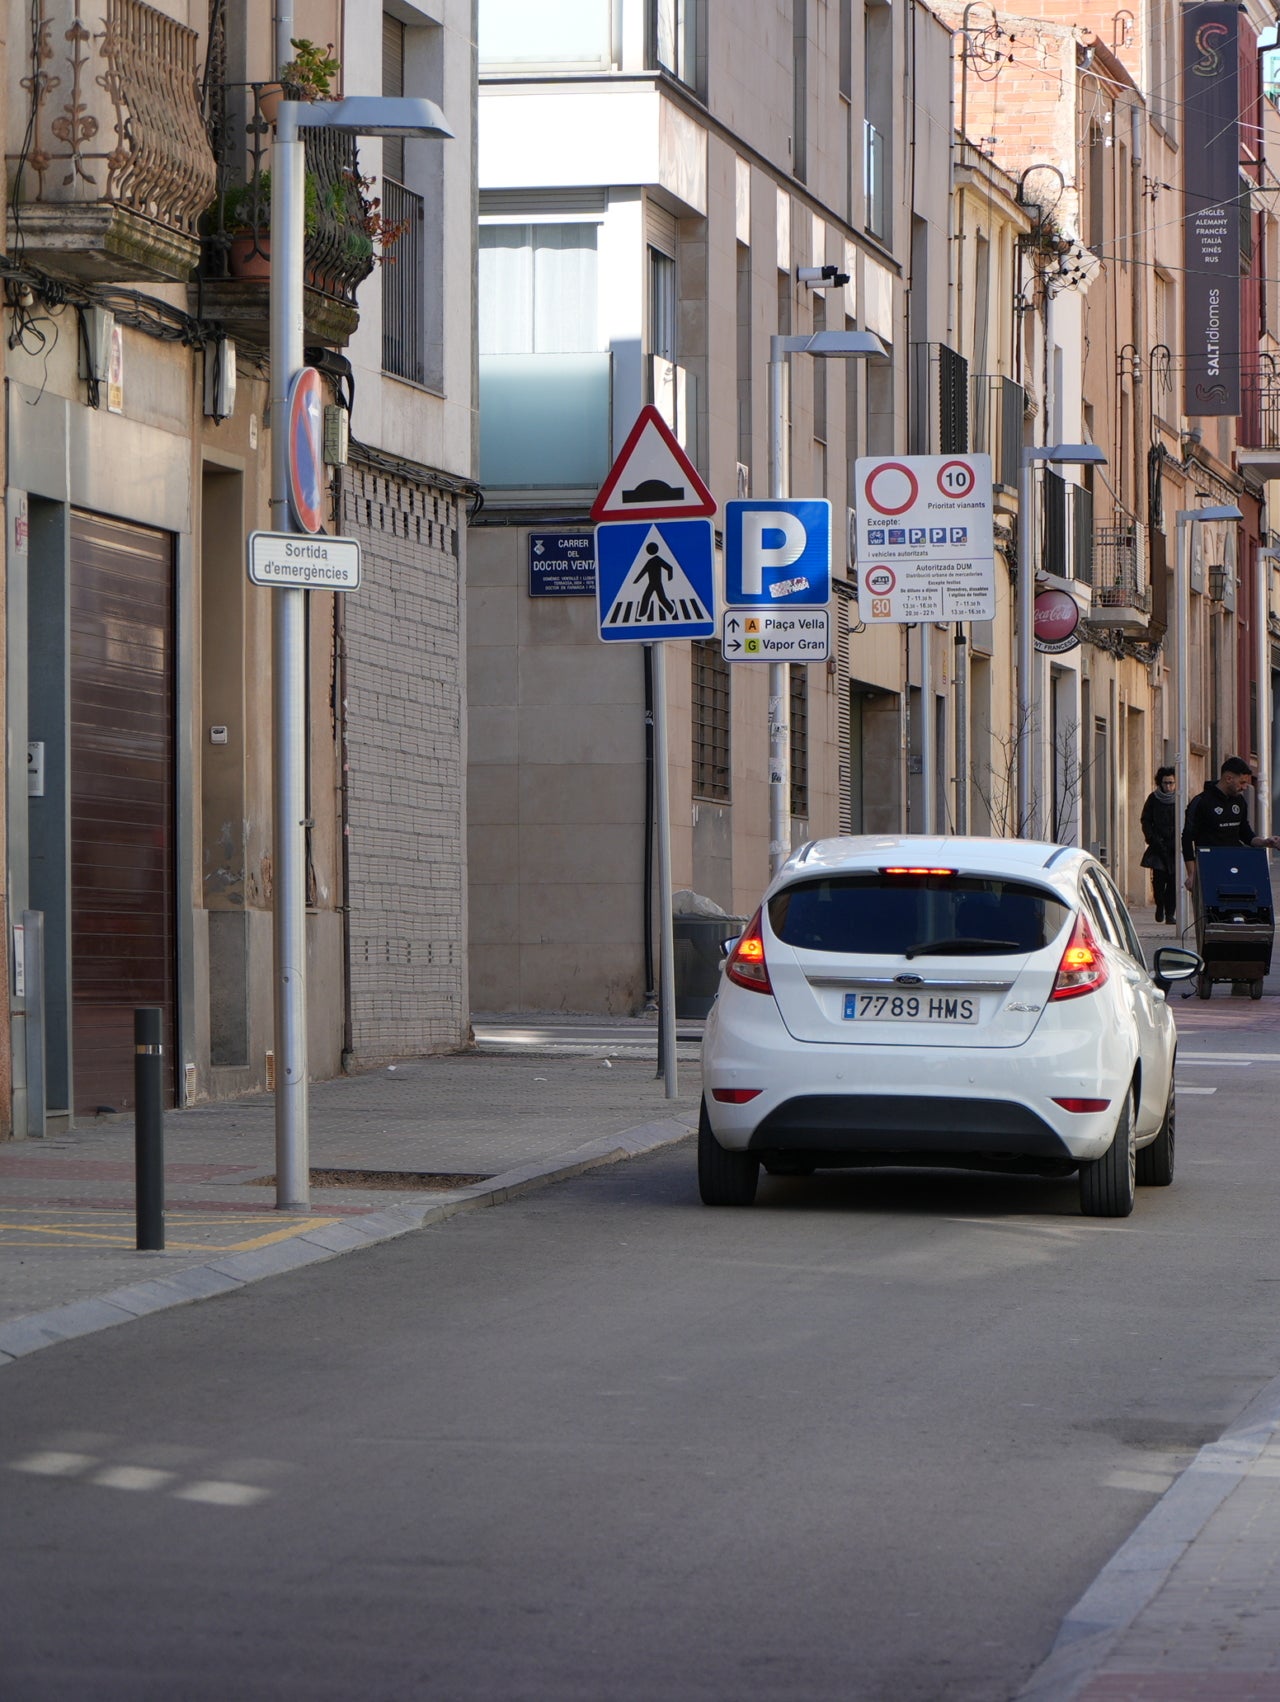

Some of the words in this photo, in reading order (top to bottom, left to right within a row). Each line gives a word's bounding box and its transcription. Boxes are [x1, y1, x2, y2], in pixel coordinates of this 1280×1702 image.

[945, 472, 967, 487] 10
[927, 502, 956, 510] Prioritat
[957, 501, 986, 509] vianants
[868, 518, 901, 527] Excepte:
[557, 539, 589, 548] CARRER
[285, 543, 328, 560] Sortida
[742, 511, 807, 594] P
[264, 561, 349, 581] d'emergències
[533, 560, 569, 571] DOCTOR
[874, 599, 889, 613] 30
[748, 620, 757, 630] A
[765, 619, 795, 632] Plaça
[798, 619, 825, 629] Vella
[748, 640, 757, 650] G
[763, 640, 794, 652] Vapor
[798, 639, 825, 649] Gran
[1045, 637, 1077, 651] FRANCESC
[860, 996, 920, 1017] 7789
[929, 998, 973, 1019] HMS
